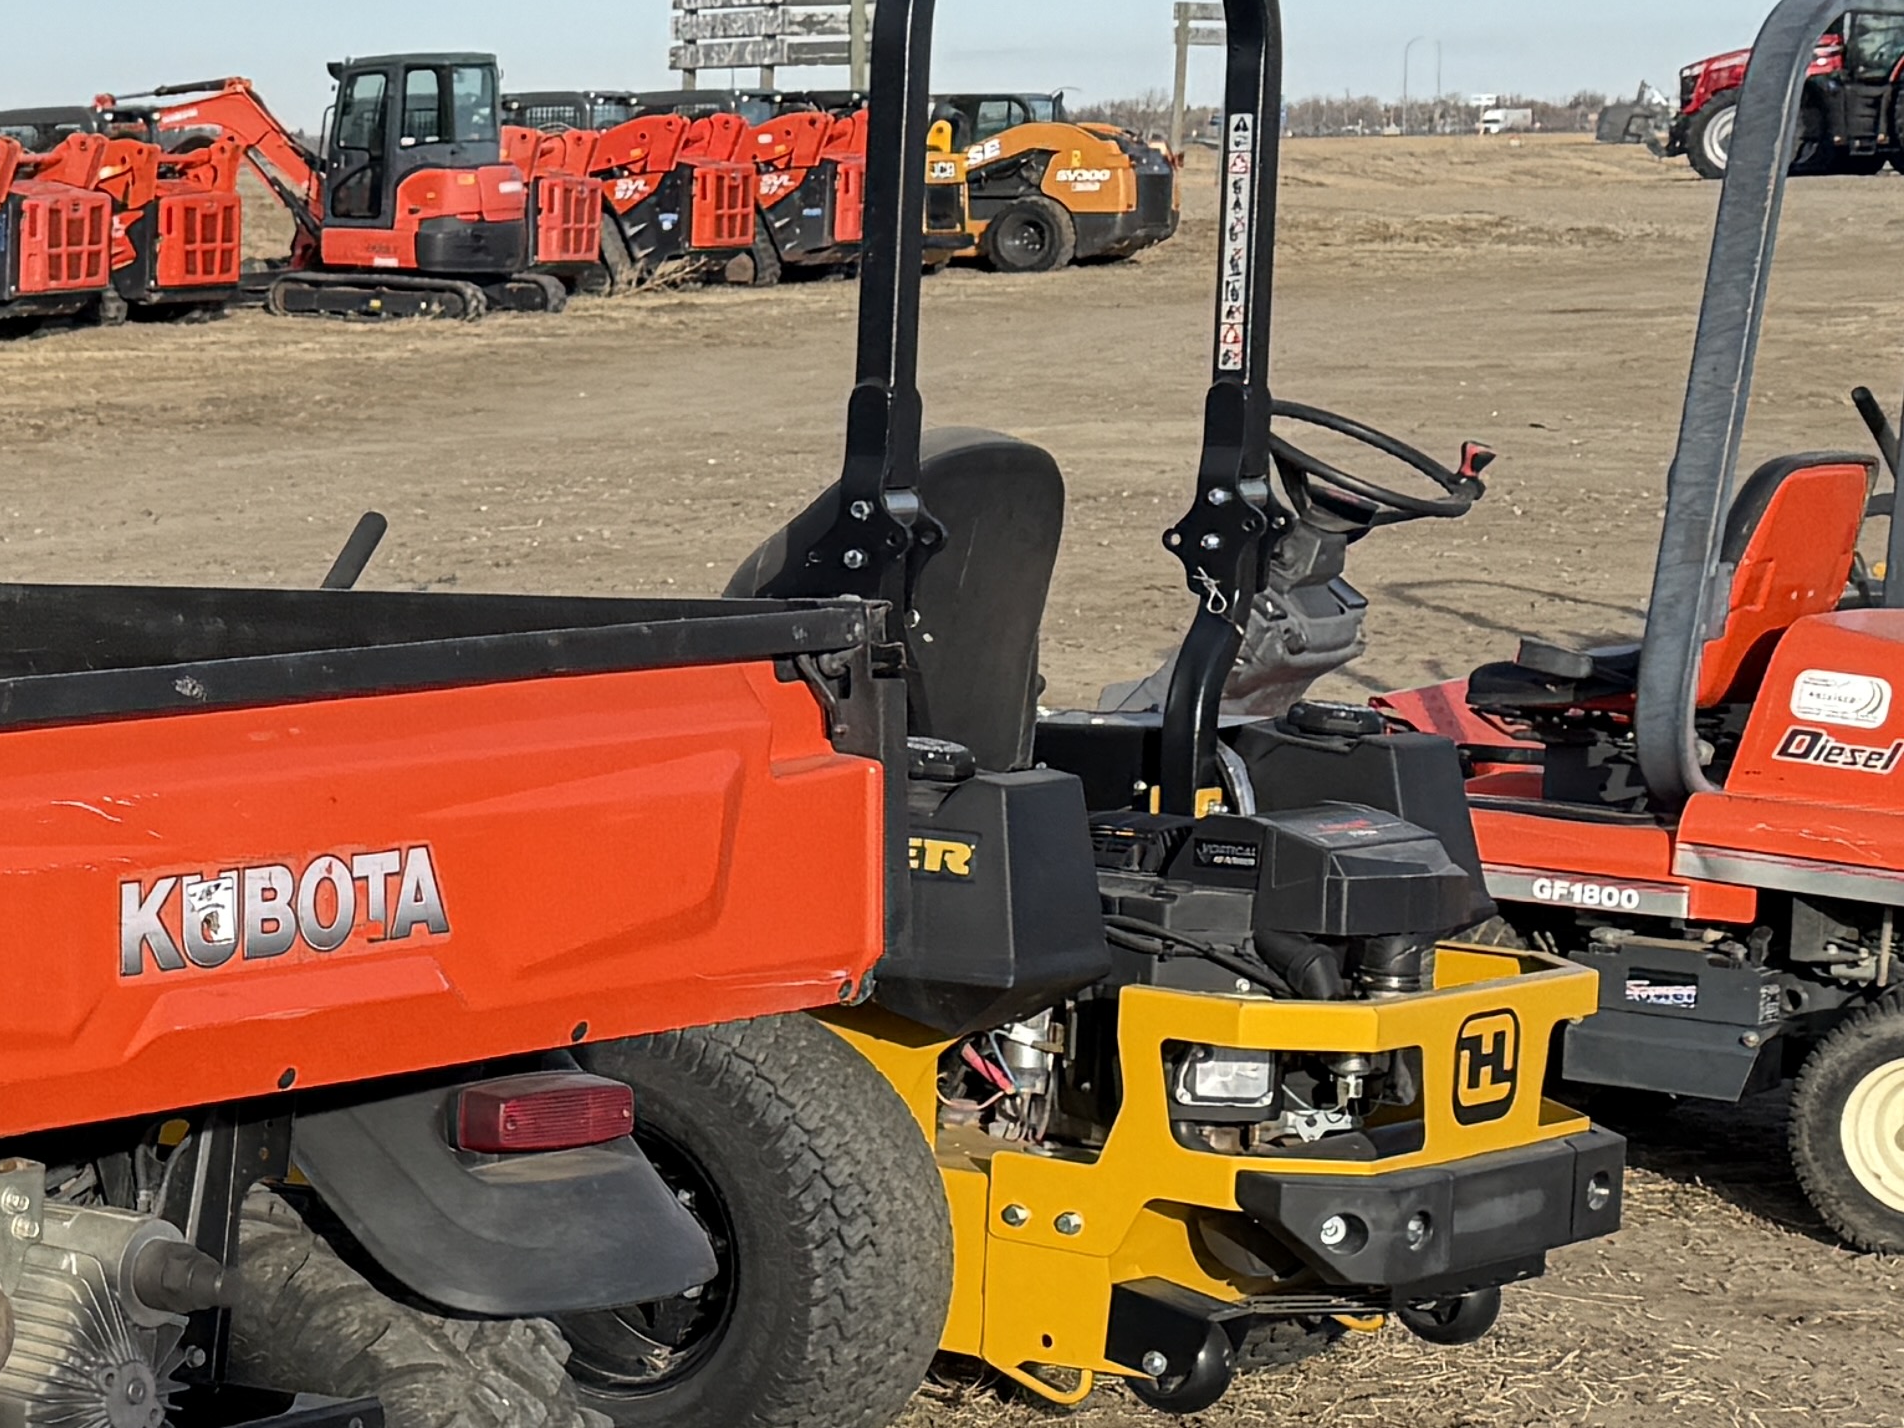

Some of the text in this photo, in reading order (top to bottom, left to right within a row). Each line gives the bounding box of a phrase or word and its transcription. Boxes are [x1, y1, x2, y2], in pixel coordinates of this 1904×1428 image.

[1774, 726, 1904, 772] Diesel
[119, 844, 450, 977] KUBOTA
[1532, 877, 1640, 909] GF1800
